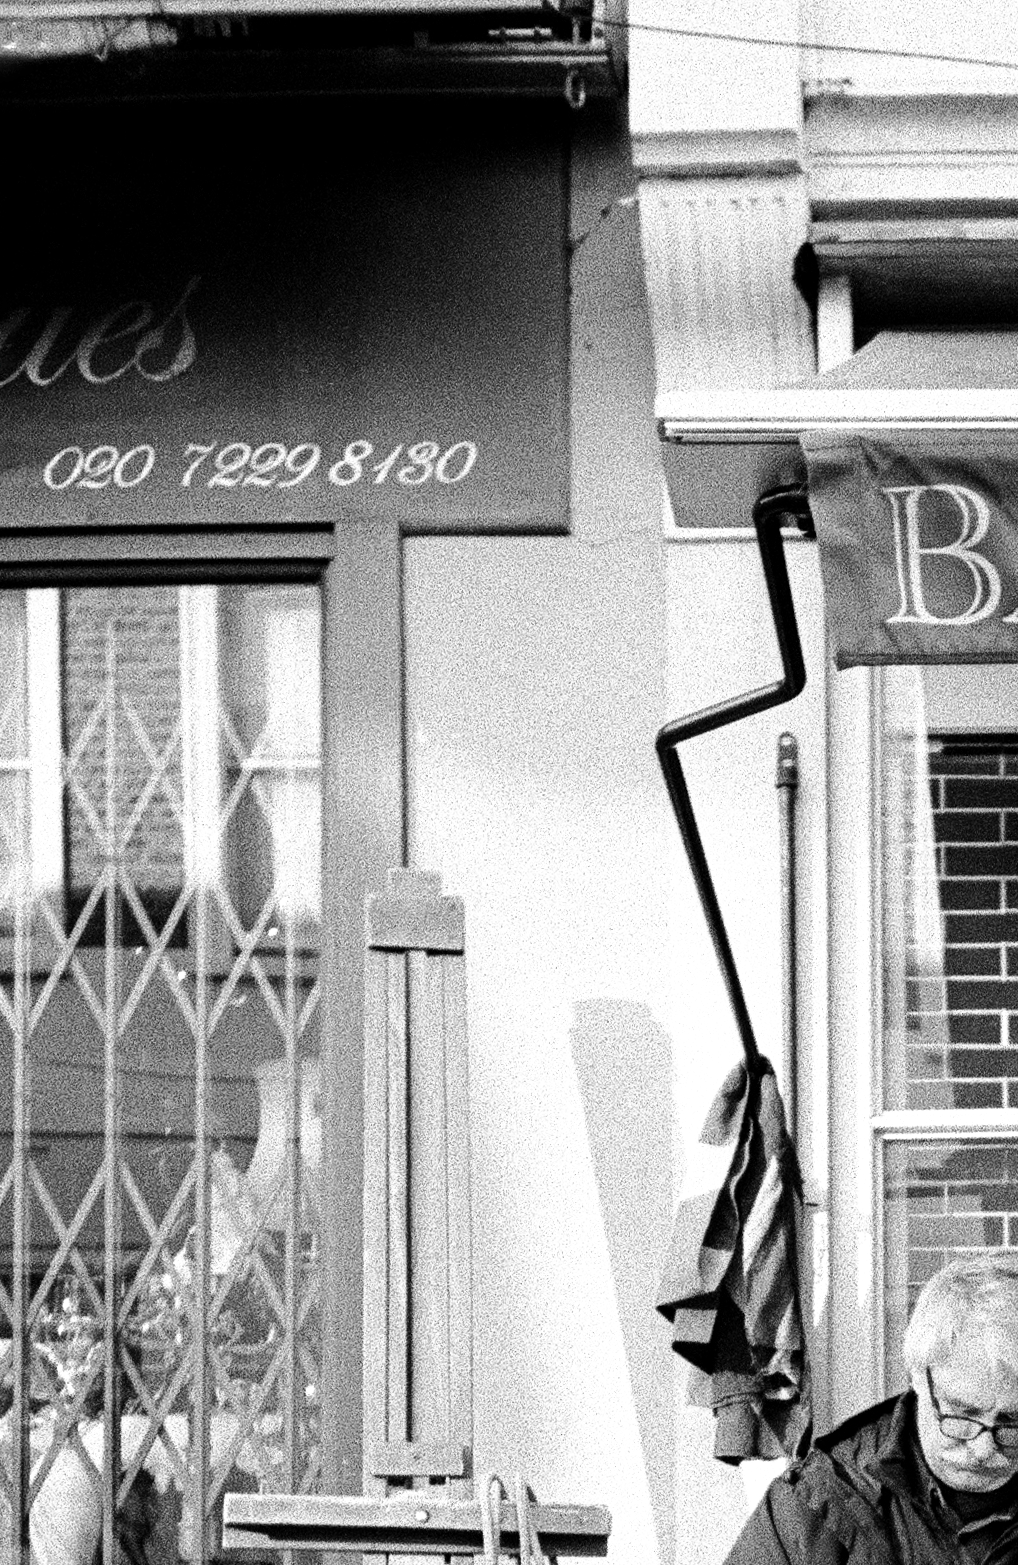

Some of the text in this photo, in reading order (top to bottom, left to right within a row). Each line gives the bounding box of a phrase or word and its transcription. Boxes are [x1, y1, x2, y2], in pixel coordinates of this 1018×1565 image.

[42, 439, 478, 490] 020 7229 8130
